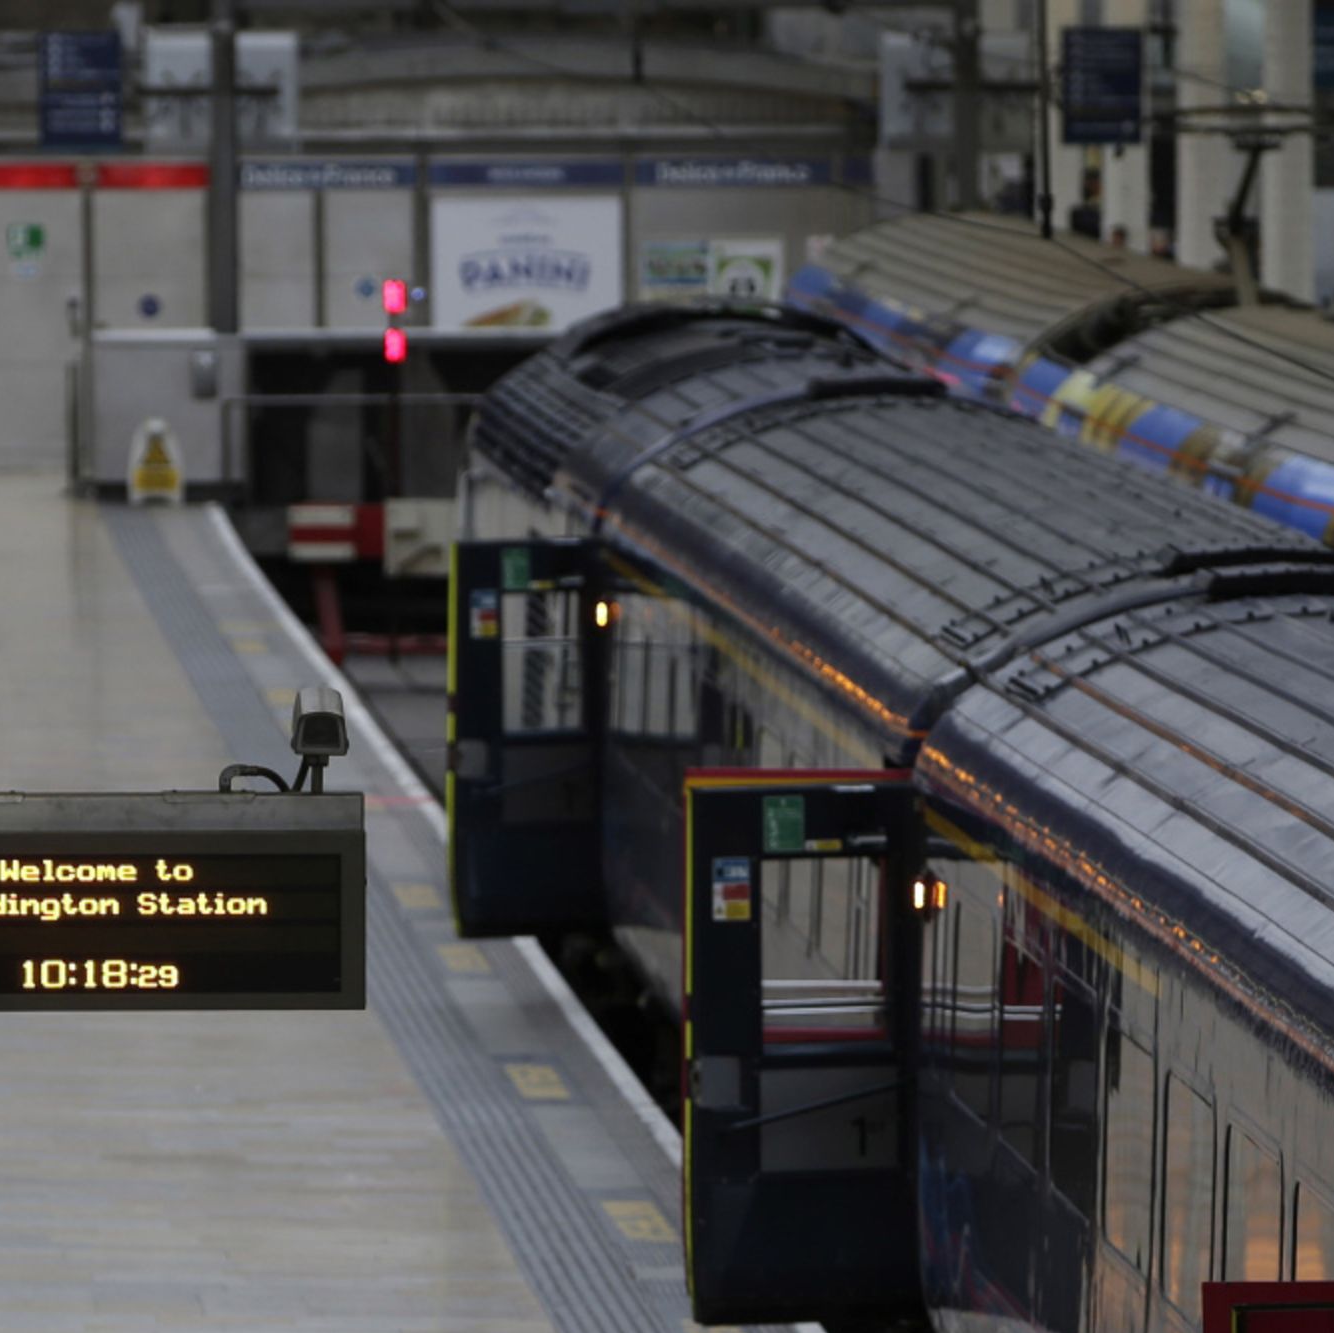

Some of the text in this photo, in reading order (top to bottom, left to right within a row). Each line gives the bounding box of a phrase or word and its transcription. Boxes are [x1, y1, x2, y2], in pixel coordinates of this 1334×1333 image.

[459, 254, 592, 293] PANINI
[0, 859, 194, 882] Welcome to
[137, 893, 268, 915] Station
[22, 960, 178, 988] 10:18:29
